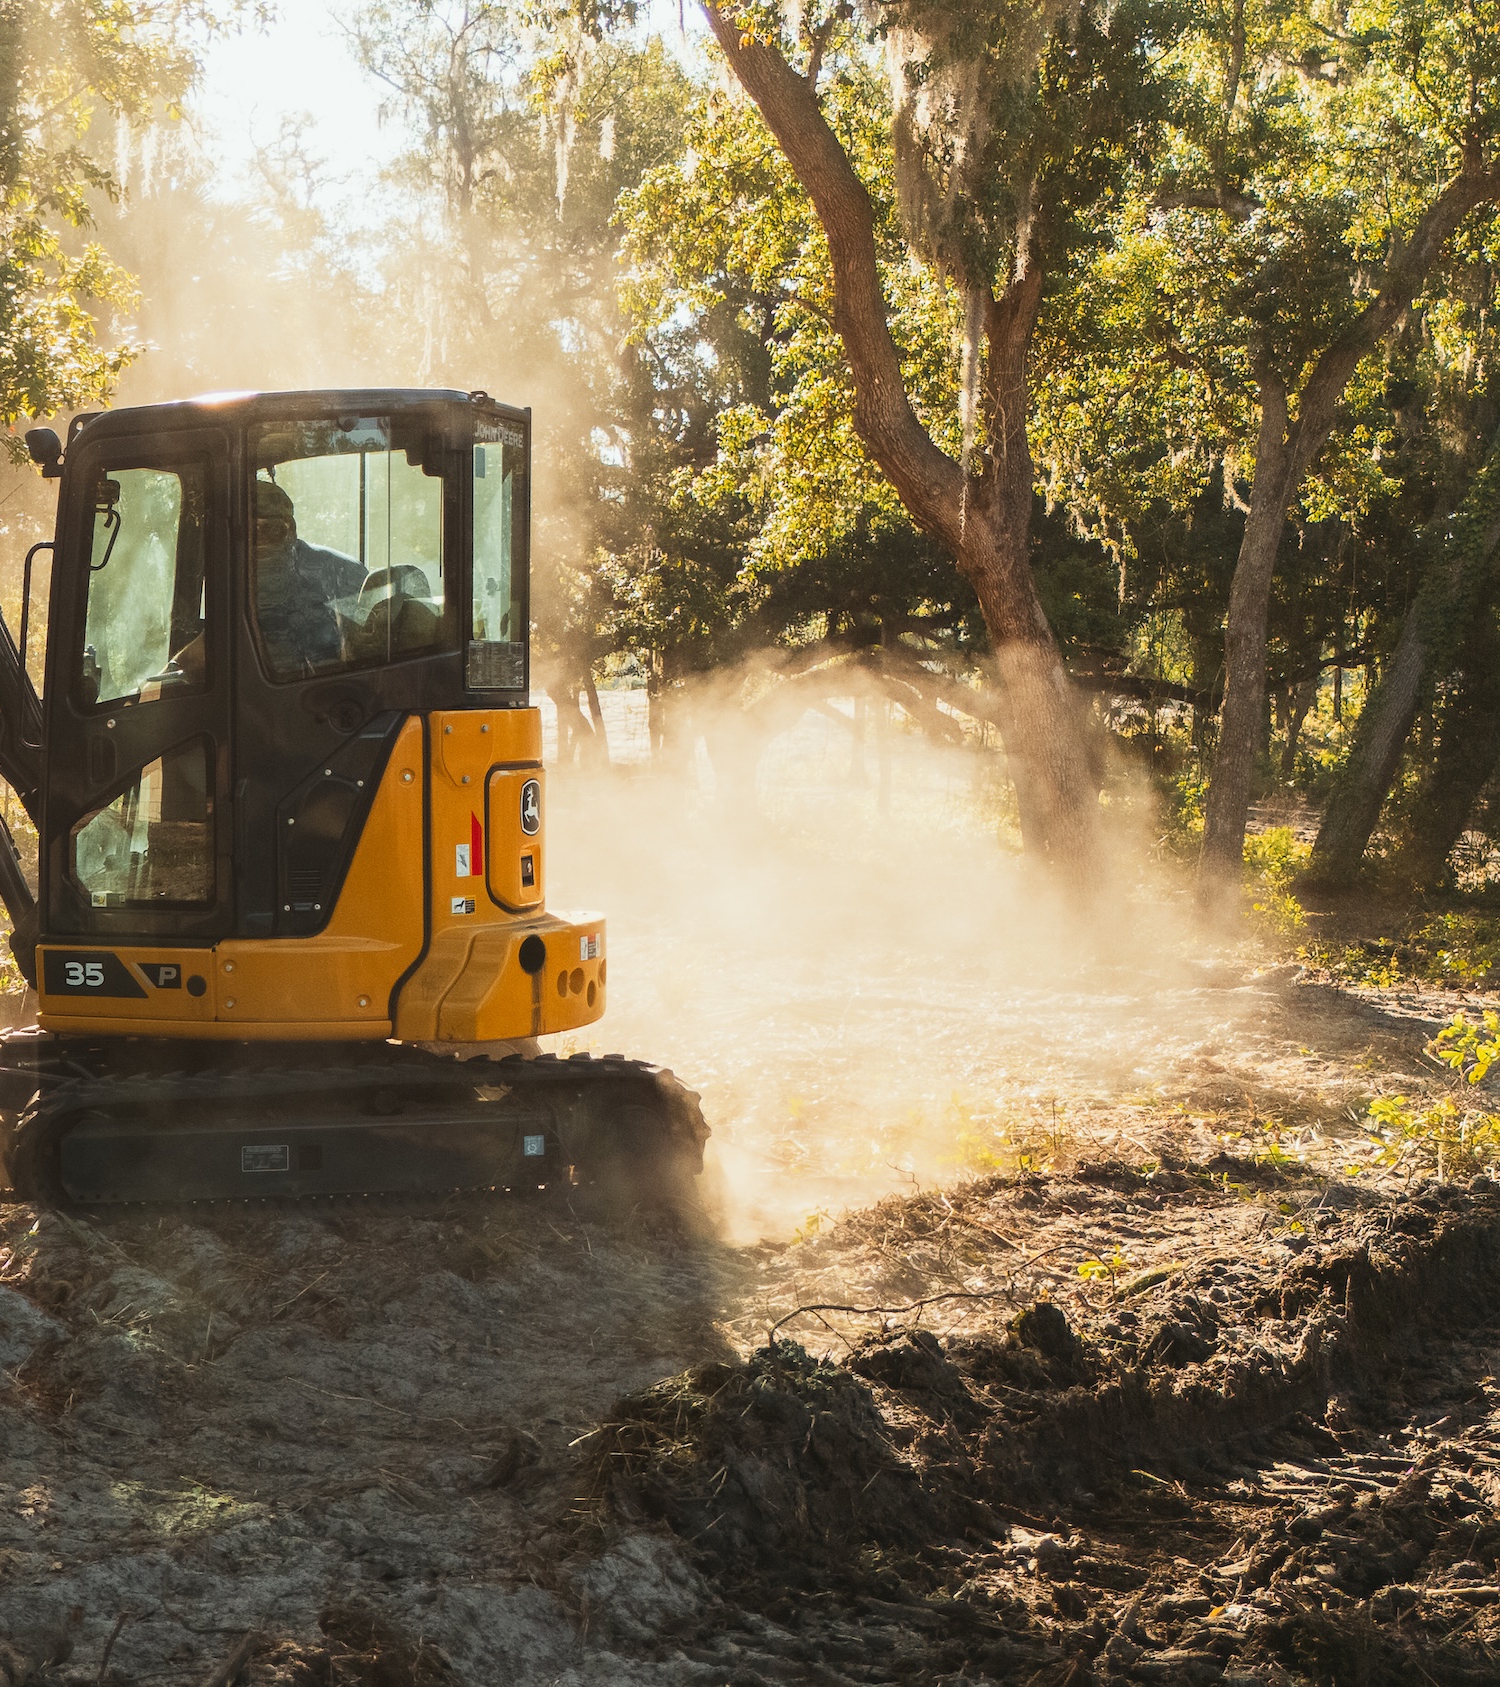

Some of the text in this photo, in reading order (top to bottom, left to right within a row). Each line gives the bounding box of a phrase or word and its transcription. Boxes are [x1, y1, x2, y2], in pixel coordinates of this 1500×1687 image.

[474, 420, 524, 448] JOHN DEERE
[64, 961, 177, 987] 35 P
